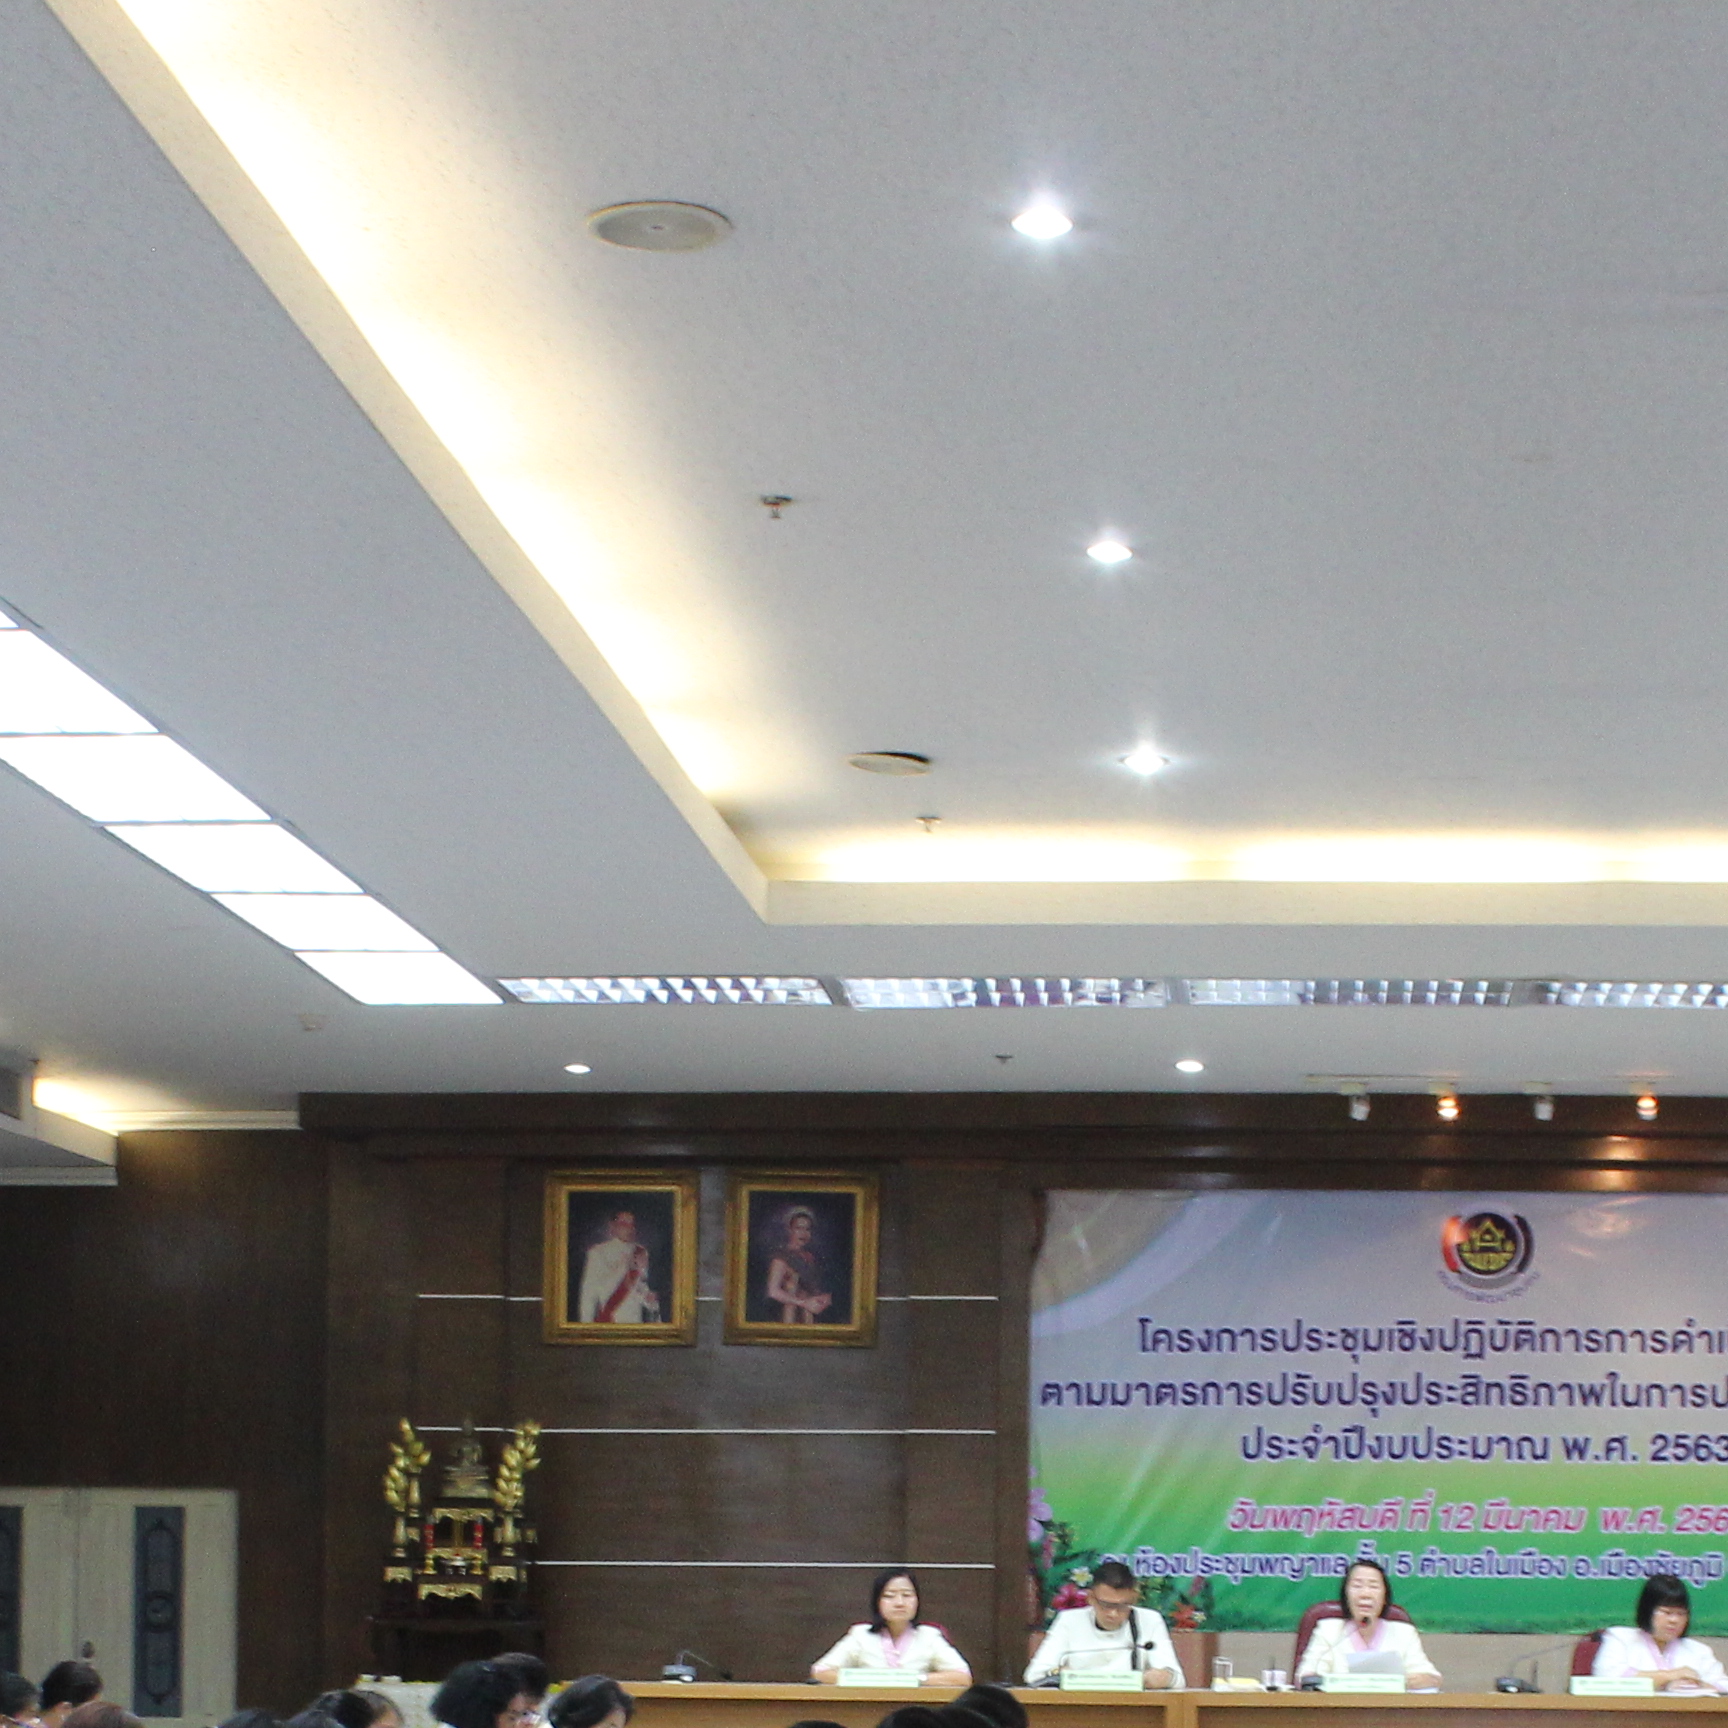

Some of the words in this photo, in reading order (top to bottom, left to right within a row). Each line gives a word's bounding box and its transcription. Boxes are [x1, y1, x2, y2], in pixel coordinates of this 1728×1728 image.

[1241, 1424, 1549, 1461] ประจำปีงบประมาณ
[1563, 1433, 1637, 1461] พ.ศ.
[1229, 1499, 1402, 1536] วันพฤหัสบดี
[1439, 1504, 1473, 1531] 12
[1481, 1498, 1586, 1532] มีนาคม
[1600, 1505, 1667, 1533] พ.ศ.
[1396, 1552, 1411, 1577] 5
